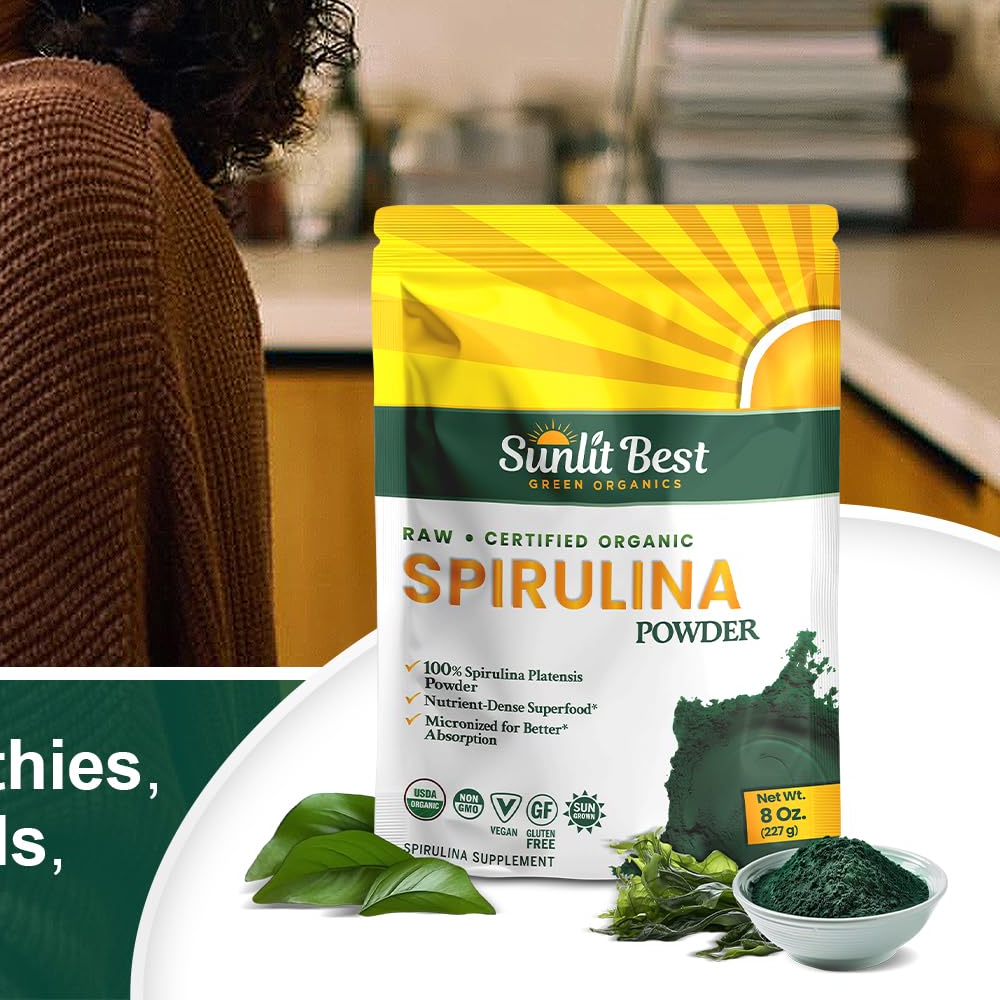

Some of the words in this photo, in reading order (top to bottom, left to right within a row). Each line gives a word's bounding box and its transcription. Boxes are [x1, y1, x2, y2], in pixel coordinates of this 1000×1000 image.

[499, 431, 614, 474] Sunlit
[620, 436, 709, 474] Best
[529, 479, 583, 490] GREEN
[593, 479, 681, 491] ORGANICS
[402, 526, 453, 544] RAW
[484, 531, 588, 548] CERTIFIED
[598, 533, 694, 549] ORGANIC
[403, 553, 741, 610] SPIRULINA
[635, 618, 760, 644] POWDER
[423, 660, 462, 677] 100%
[465, 666, 525, 681] Spirulina
[528, 669, 583, 683] Platensis
[425, 677, 478, 692] Powder
[424, 695, 525, 713] Nutrient-Dense
[425, 715, 498, 732] Micronized
[501, 721, 520, 733] for
[424, 729, 497, 746] Absorption
[413, 788, 437, 799] USDA
[459, 793, 479, 803] NON
[757, 792, 781, 804] Net
[783, 790, 806, 801] Wt.
[410, 800, 440, 810] ORGANIC
[458, 803, 479, 814] GMO
[531, 801, 553, 819] GF
[573, 802, 596, 813] SUN
[573, 812, 596, 820] GROWN
[760, 807, 772, 823] 8
[776, 806, 806, 821] Oz.
[490, 825, 518, 837] VEGAN
[526, 829, 556, 838] GLUTEN
[761, 825, 784, 839] (227
[786, 825, 798, 838] g)
[526, 838, 556, 849] FREE
[404, 842, 468, 861] SPIRULINA
[472, 851, 555, 867] SUPPLEMENT
